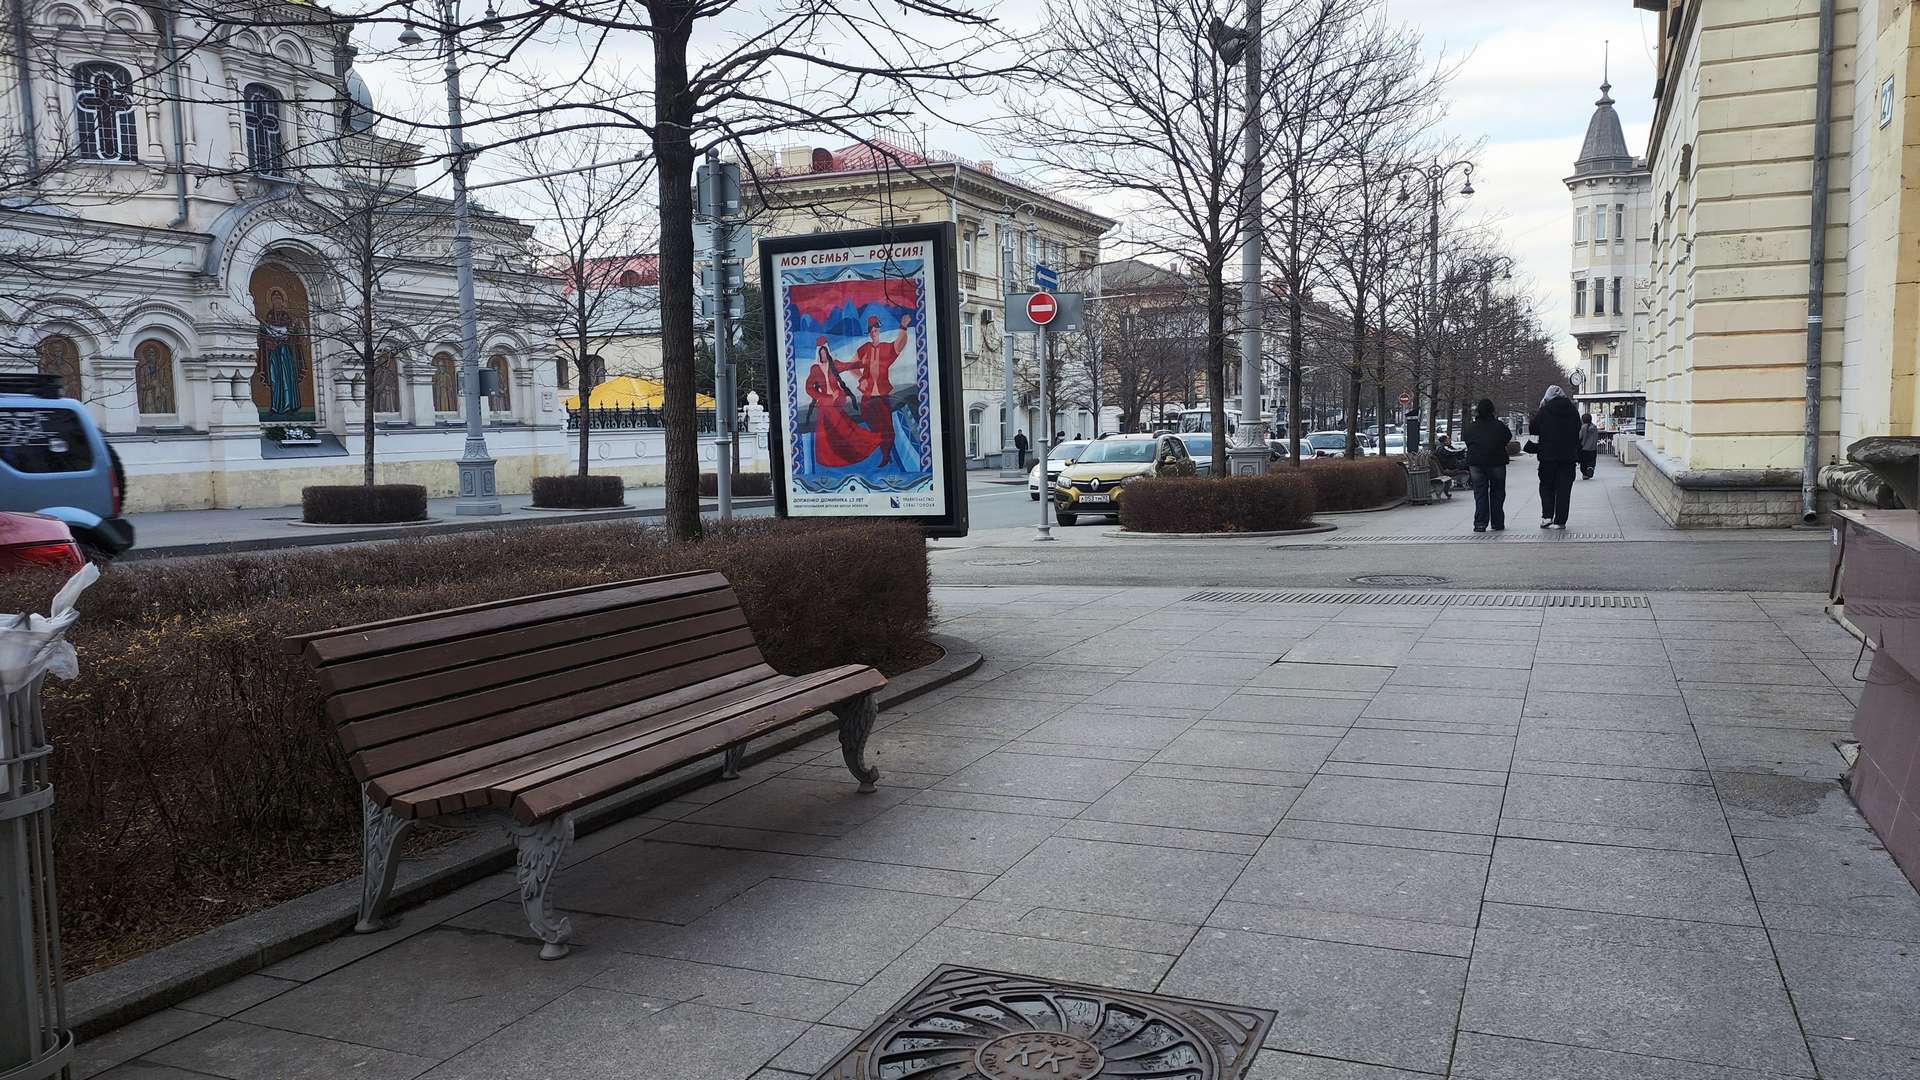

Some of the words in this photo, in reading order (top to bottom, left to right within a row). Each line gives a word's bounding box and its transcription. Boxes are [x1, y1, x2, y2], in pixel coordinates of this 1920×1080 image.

[1882, 83, 1893, 119] 27
[781, 256, 806, 266] МОЯ
[811, 252, 848, 265] СЕМЬЯ
[870, 246, 923, 260] РОССИЯ!
